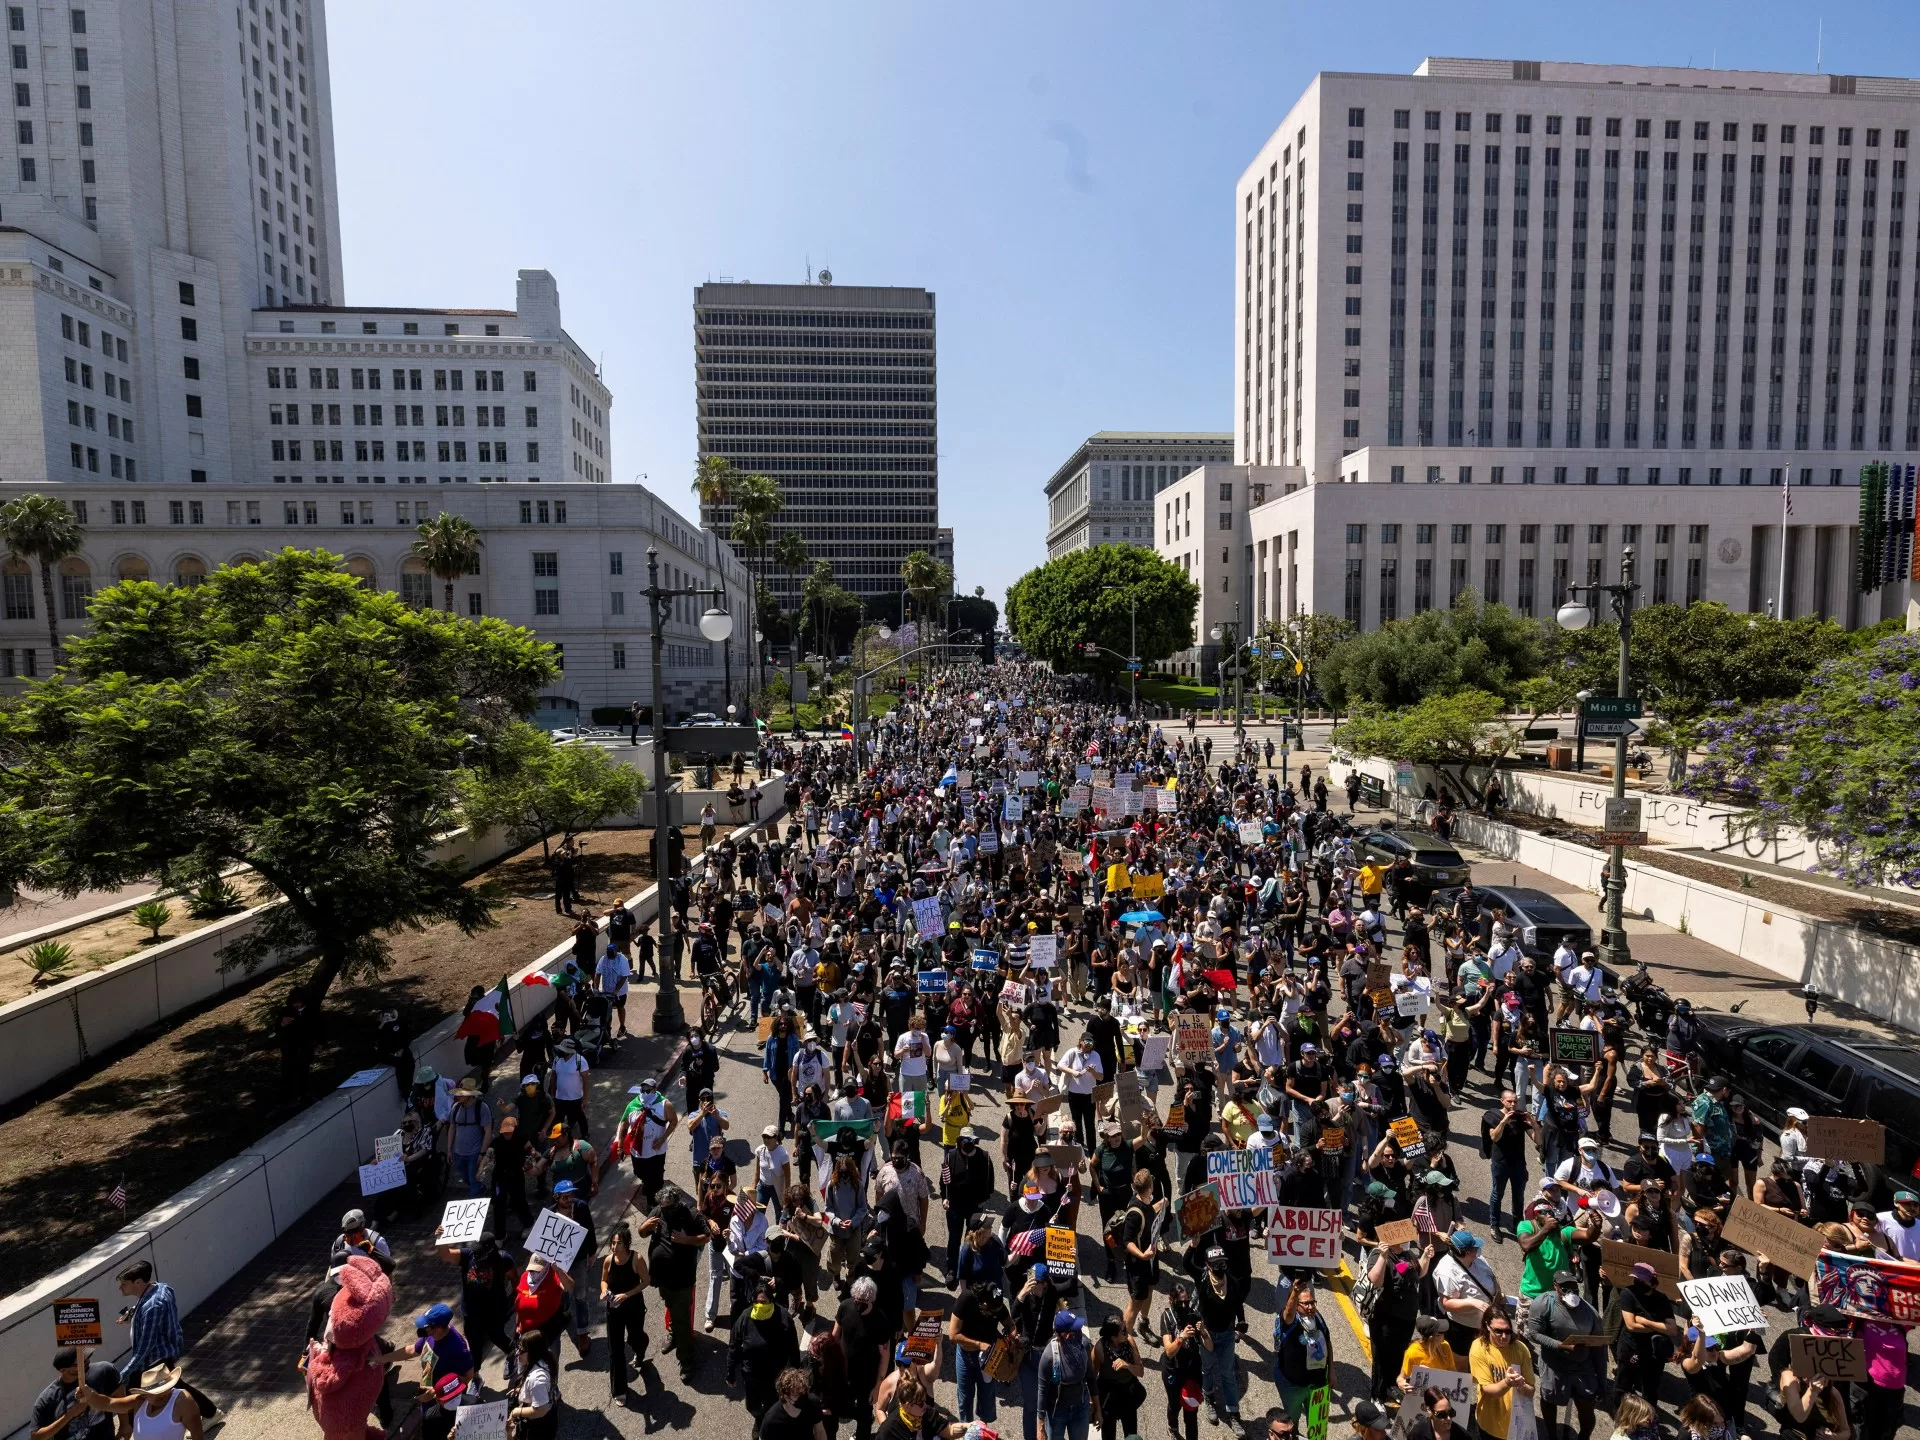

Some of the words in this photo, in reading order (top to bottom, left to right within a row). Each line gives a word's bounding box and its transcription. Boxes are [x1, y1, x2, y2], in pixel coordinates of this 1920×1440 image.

[1590, 704, 1618, 712] Main
[1624, 704, 1636, 712] St
[1646, 801, 1700, 827] ICE
[916, 898, 936, 910] ICE
[1178, 1029, 1209, 1038] MELTING
[1187, 1040, 1209, 1050] POINT
[1558, 1042, 1578, 1050] CAME
[1186, 1052, 1196, 1060] OF
[1198, 1051, 1211, 1060] ICE
[1396, 1130, 1418, 1138] Fascist
[1208, 1151, 1236, 1174] COME
[1237, 1150, 1254, 1173] FOR
[1254, 1148, 1273, 1171] ONE
[366, 1175, 386, 1191] FUCK
[1238, 1173, 1256, 1206] US
[446, 1202, 487, 1221] FUCK
[1271, 1207, 1342, 1233] ABOLISH
[442, 1221, 476, 1238] ICE
[542, 1216, 580, 1248] FUCK
[1384, 1227, 1413, 1242] NAZIS
[1048, 1242, 1072, 1250] Fascist
[1051, 1235, 1071, 1244] Trump
[1272, 1234, 1335, 1259] ICE!
[535, 1237, 566, 1263] ICE
[1048, 1250, 1074, 1259] Regime
[1049, 1267, 1074, 1275] NOW!!!
[1683, 1285, 1711, 1307] GO
[1710, 1281, 1750, 1304] AWAY
[1803, 1338, 1855, 1361] FUCK
[1812, 1358, 1854, 1378] ICE
[471, 1414, 491, 1425] HIJA
